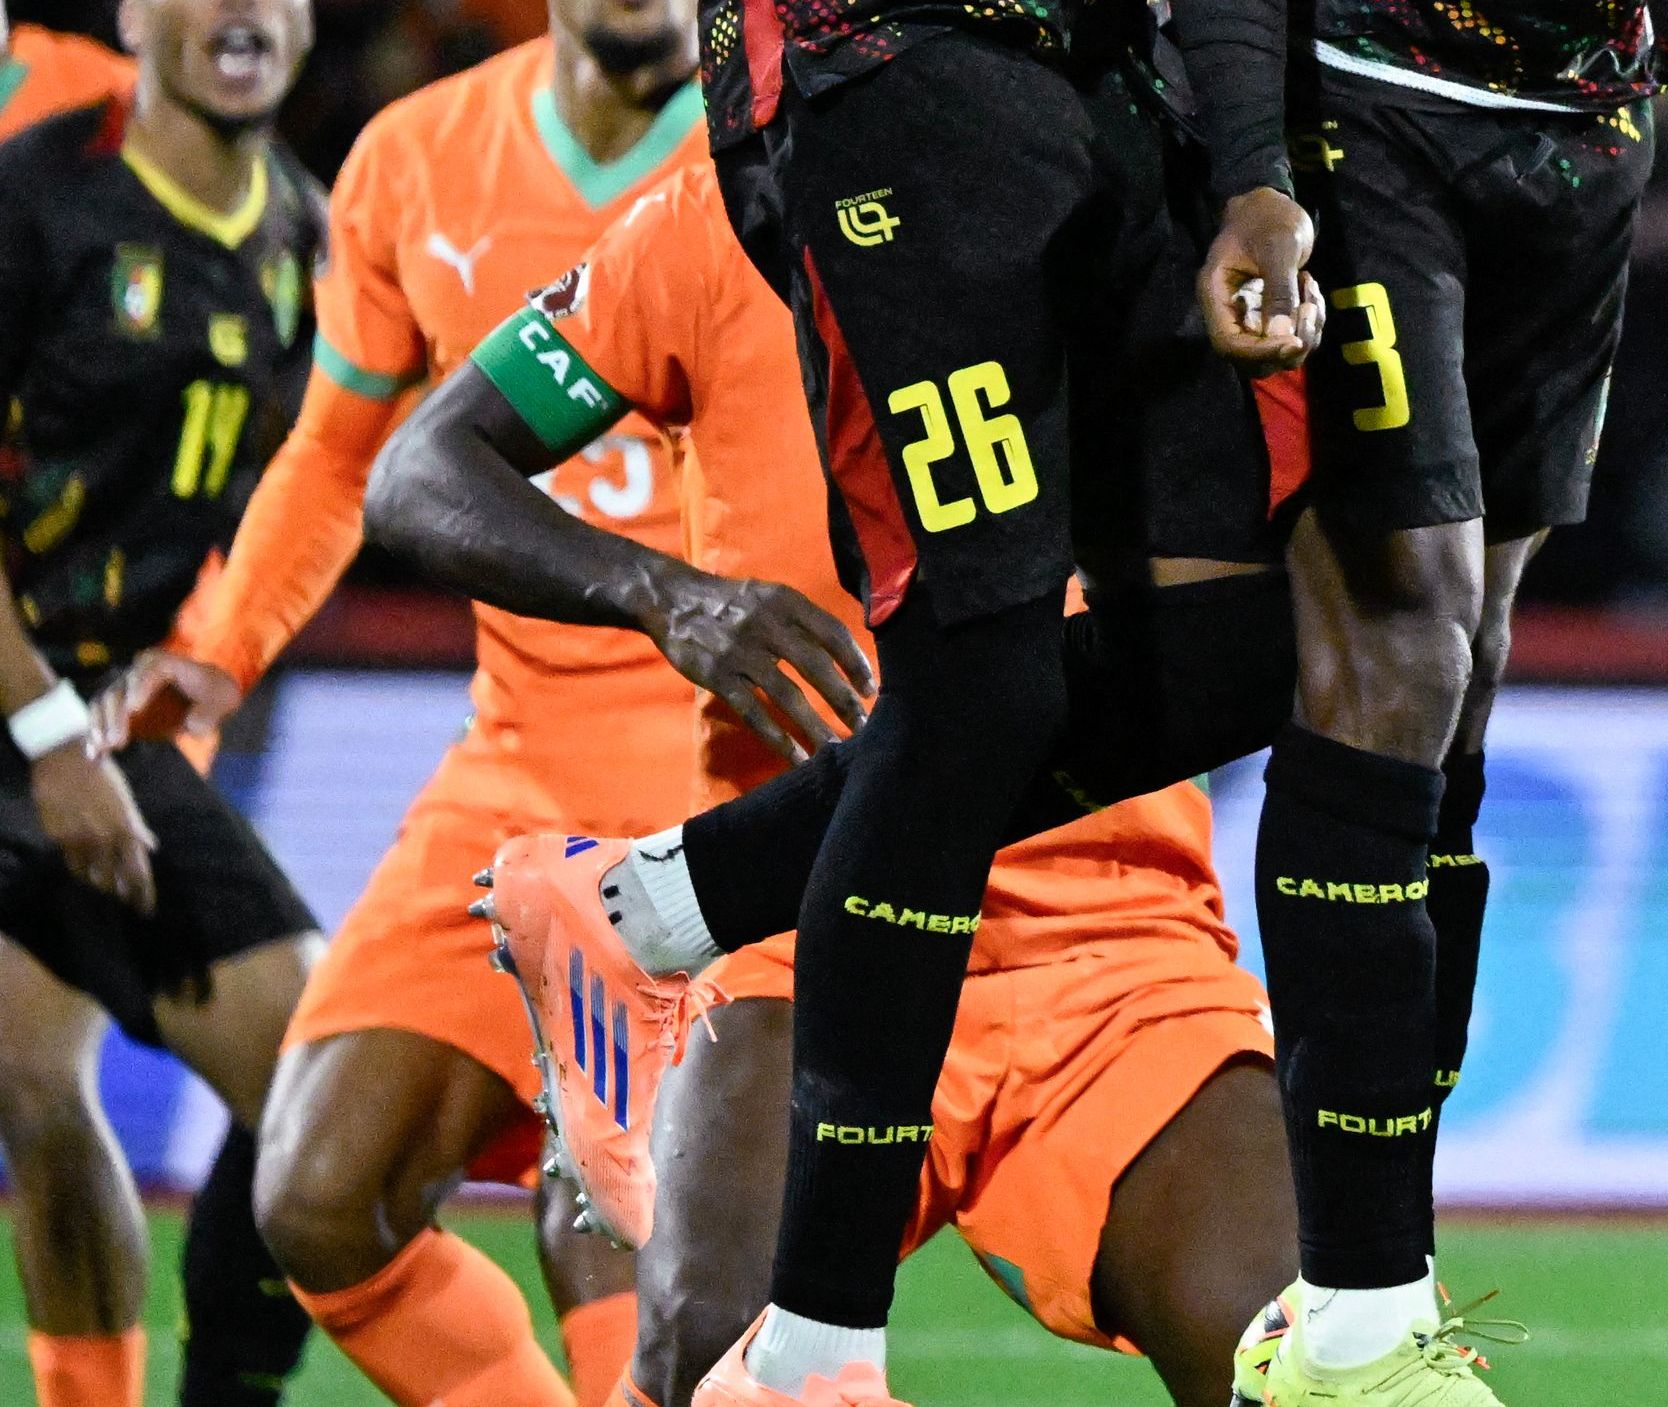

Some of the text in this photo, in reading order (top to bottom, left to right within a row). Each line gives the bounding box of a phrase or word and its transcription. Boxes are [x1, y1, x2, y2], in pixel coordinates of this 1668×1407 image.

[834, 187, 894, 209] FOURTEEN
[518, 320, 603, 409] CAF
[1331, 281, 1412, 433] 3
[170, 378, 250, 502] 11
[888, 360, 1040, 534] 26
